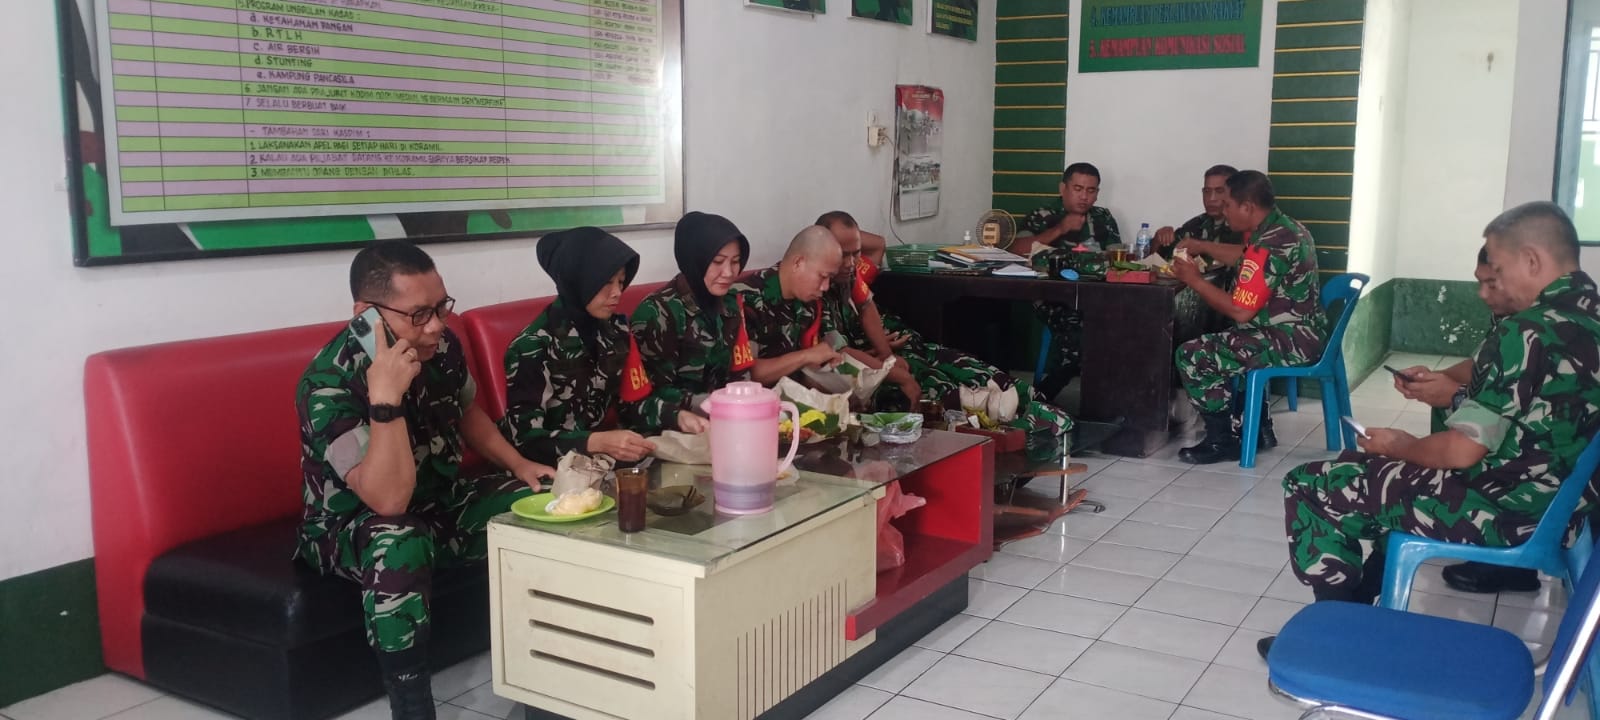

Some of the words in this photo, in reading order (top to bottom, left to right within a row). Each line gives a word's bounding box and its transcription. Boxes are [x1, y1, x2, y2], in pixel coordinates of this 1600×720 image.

[267, 43, 283, 51] AIR
[287, 45, 320, 55] BERSIH
[267, 56, 312, 67] STUNTING
[269, 71, 310, 81] KAMPUNG
[313, 73, 355, 84] PANCASILA
[257, 98, 289, 108] SELALU
[291, 100, 327, 110] BERBUAT
[258, 141, 311, 150] LAKSANAKAN
[380, 142, 397, 151] HARI
